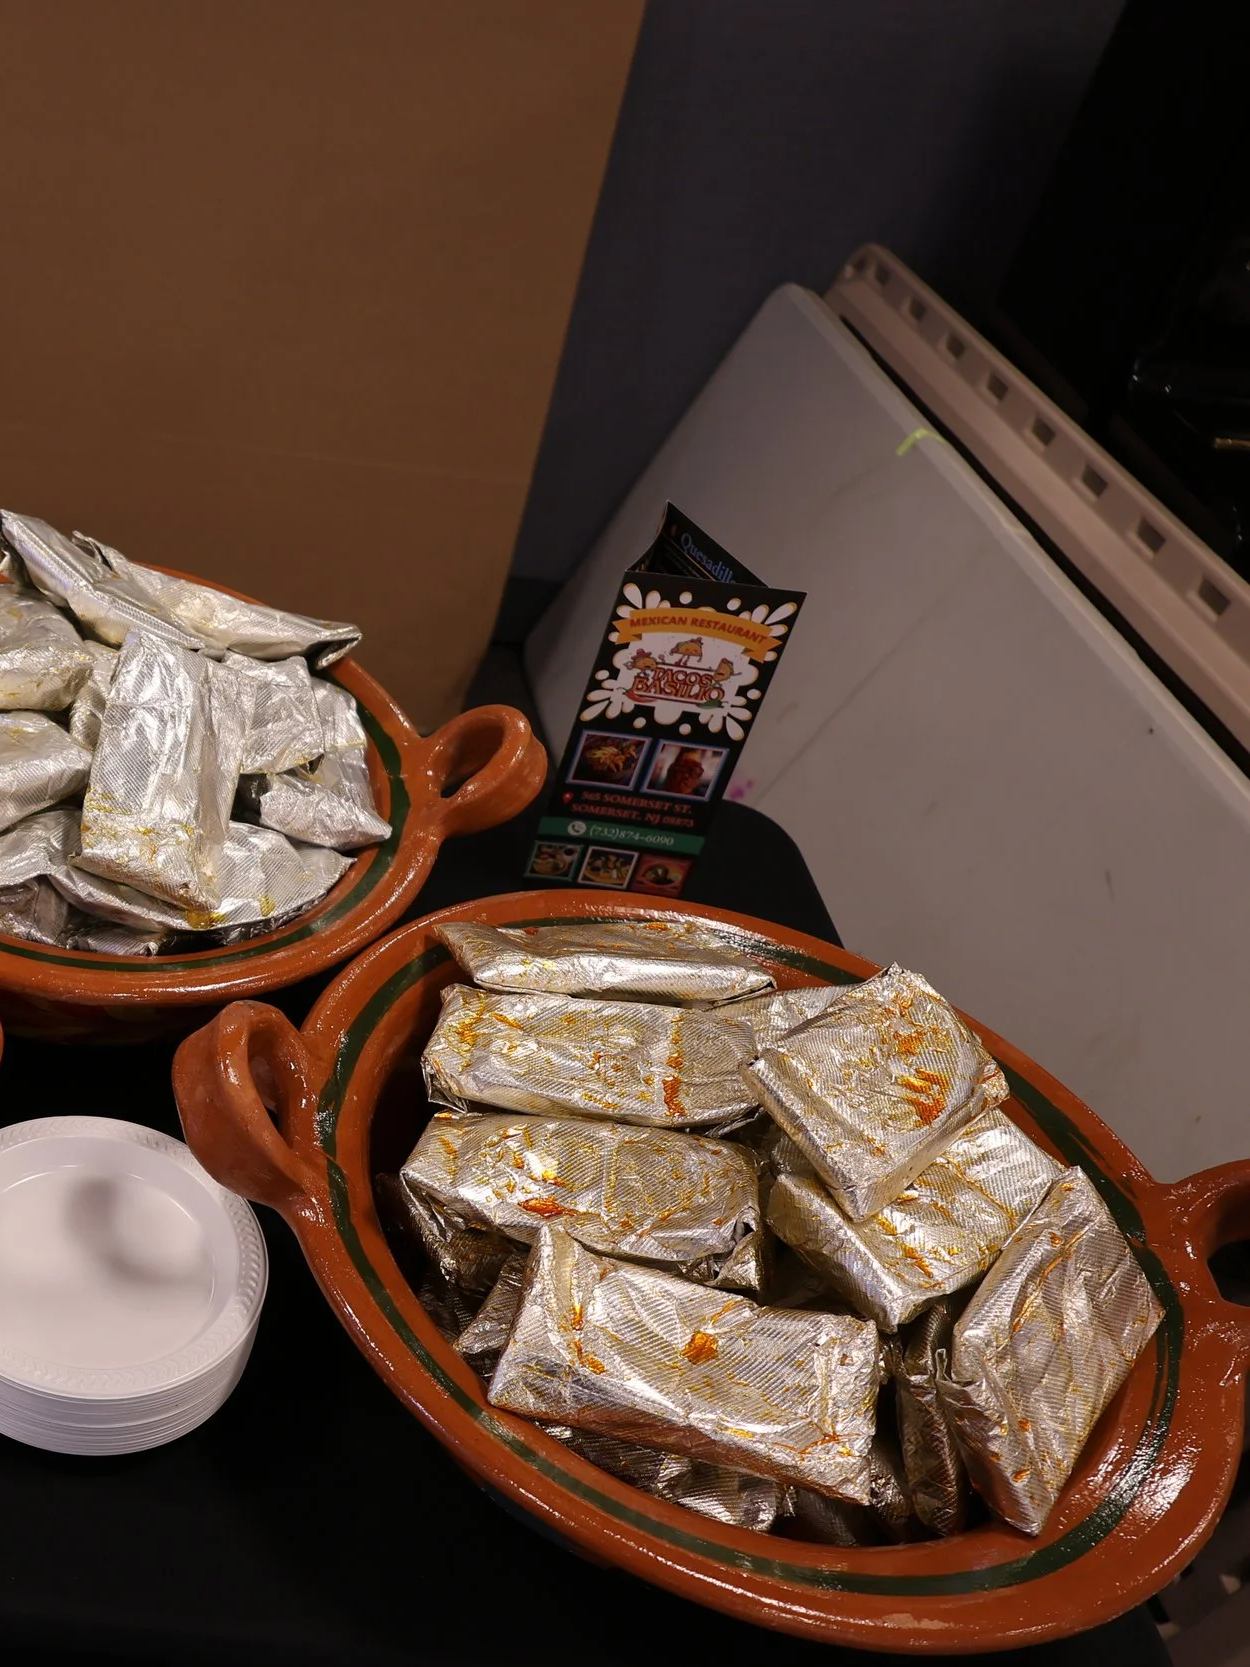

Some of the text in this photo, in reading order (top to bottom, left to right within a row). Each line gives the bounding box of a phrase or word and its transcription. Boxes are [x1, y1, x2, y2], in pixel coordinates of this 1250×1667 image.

[629, 615, 768, 645] MEXICAN RESTAURANT
[632, 676, 725, 701] BASILIO
[654, 668, 715, 688] TACOS
[603, 793, 672, 811] SOMERSET
[673, 803, 692, 814] ST.
[644, 812, 661, 825] NJ
[589, 824, 675, 847] (732)874-6090
